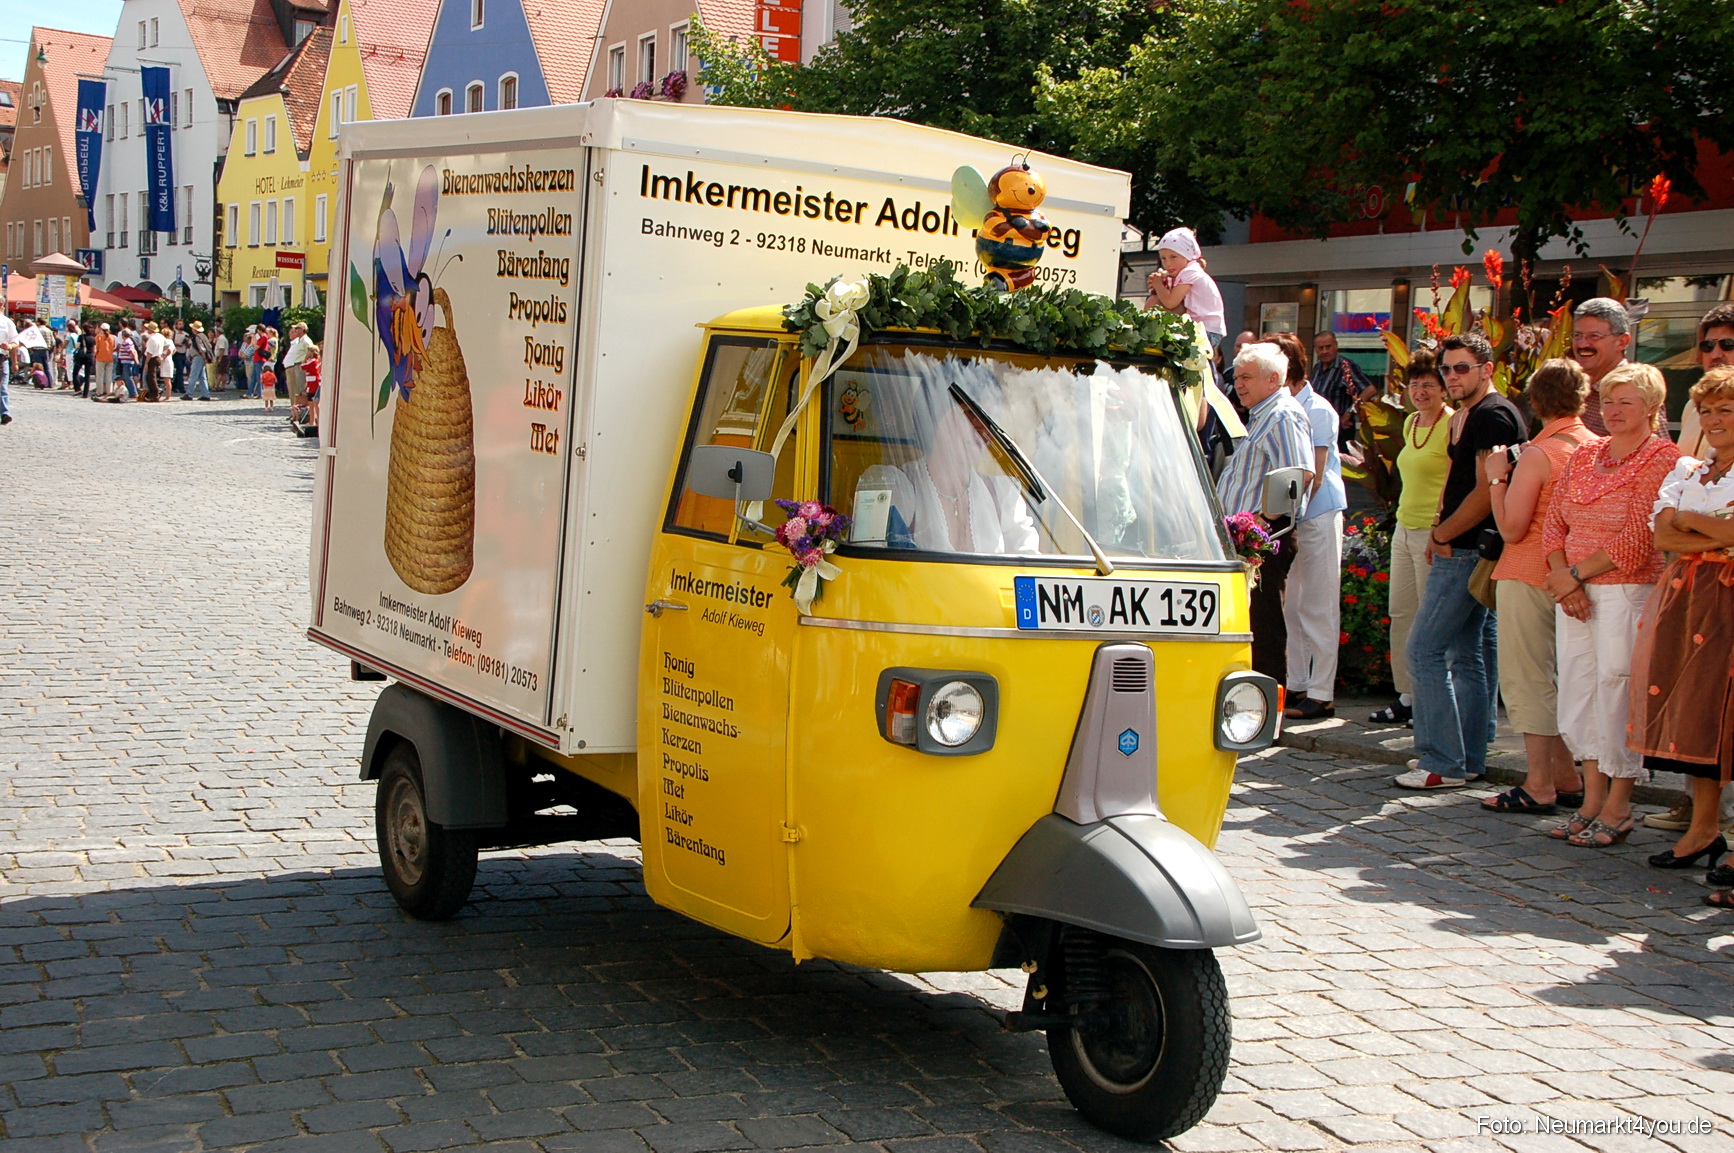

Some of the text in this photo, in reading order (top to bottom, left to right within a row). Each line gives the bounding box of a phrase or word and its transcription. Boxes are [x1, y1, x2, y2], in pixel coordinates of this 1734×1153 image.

[157, 130, 168, 212] K&L RUPPERT
[256, 176, 276, 194] HOTEL
[442, 164, 575, 196] Bienenwachskerzen
[640, 164, 868, 225] Imkermeister
[487, 207, 572, 242] Blütenpollen
[277, 256, 303, 264] WISSMAC
[641, 218, 724, 247] Bahnweg
[729, 229, 740, 246] 2
[756, 232, 806, 254] 92318
[812, 239, 891, 264] Neumarkt
[1034, 266, 1077, 284] 20573
[497, 250, 569, 287] Bärenfang
[509, 292, 567, 328] Propolis
[524, 336, 564, 374] Honig
[523, 379, 562, 411] Likör
[530, 422, 559, 455] Met
[670, 568, 773, 609] Imkermeister
[1038, 584, 1216, 627] NM AK 139
[379, 591, 482, 648] Imkermeister Adolf Kieweg
[701, 608, 765, 637] Adolf Kieweg
[1024, 608, 1031, 620] D
[334, 597, 365, 626] Bahnweg
[366, 609, 372, 625] 2
[376, 614, 398, 636] 92318
[399, 623, 437, 652] Neumarkt
[443, 640, 476, 668] Telefon:
[477, 653, 509, 685] (09181)
[511, 666, 538, 692] 20573
[664, 651, 695, 679] Honig
[663, 677, 734, 711] Blütenpollen
[662, 702, 741, 738] Bienenwachs-
[662, 727, 702, 755] Kerzen
[662, 752, 709, 782] Propolis
[663, 777, 685, 800] Met
[665, 802, 693, 826] Likör
[665, 826, 726, 866] Bärenfang
